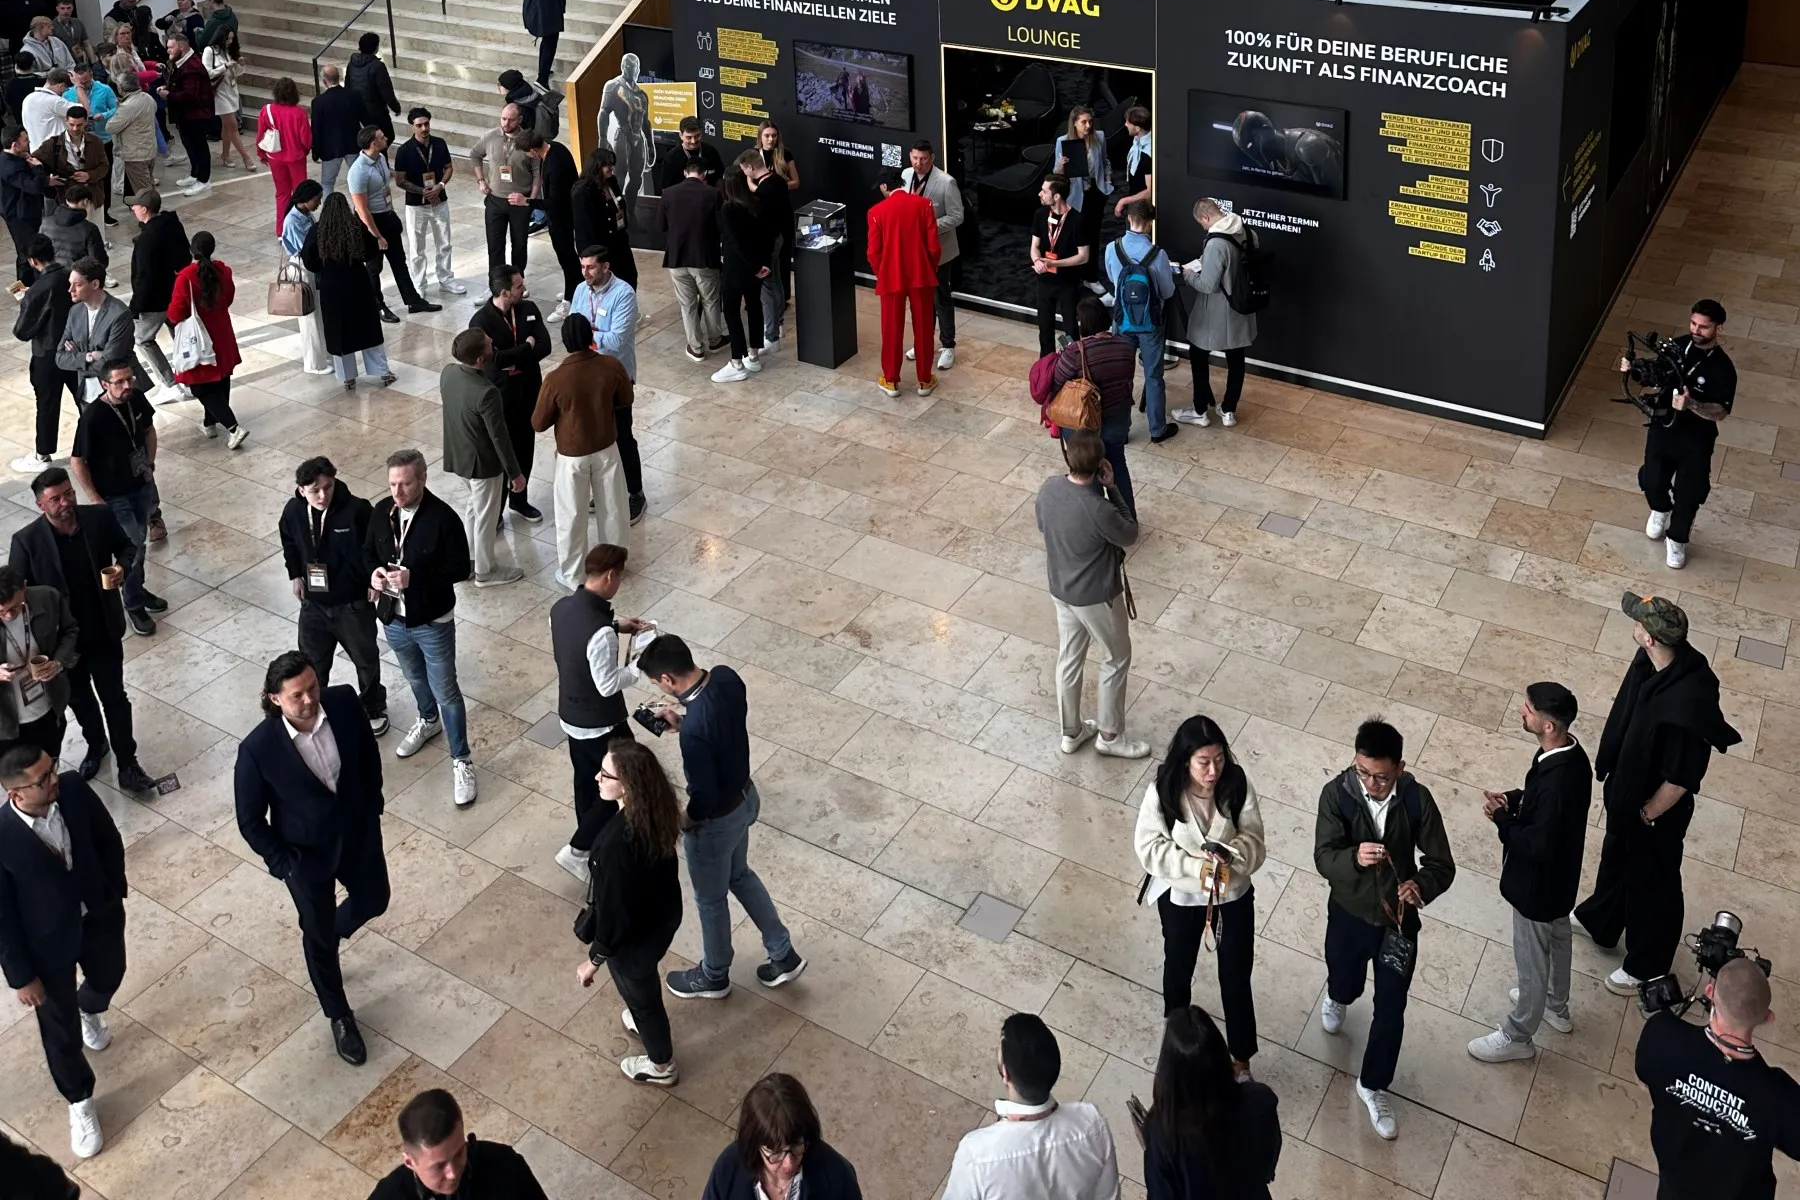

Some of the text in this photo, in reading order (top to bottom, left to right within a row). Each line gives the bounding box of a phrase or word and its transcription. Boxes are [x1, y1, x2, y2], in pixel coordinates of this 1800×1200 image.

[859, 9, 896, 25] ZIELE
[1008, 26, 1080, 49] LOUNGE
[1225, 29, 1507, 74] 100% FÜR DEINE BERUFLICHE
[1228, 51, 1506, 98] ZUKUNFT ALS FINANZCOACH
[818, 137, 873, 152] JETZT HIER TERMIN
[831, 147, 874, 159] VEREINBAREN!
[1242, 209, 1319, 227] JETZT HIER TERMIN
[1242, 218, 1301, 233] VEREINBAREN!
[1419, 222, 1442, 230] DEINEN
[1444, 226, 1465, 234] COACH
[1689, 1073, 1745, 1110] CONTENT
[1675, 1079, 1748, 1127] PRODUCTION
